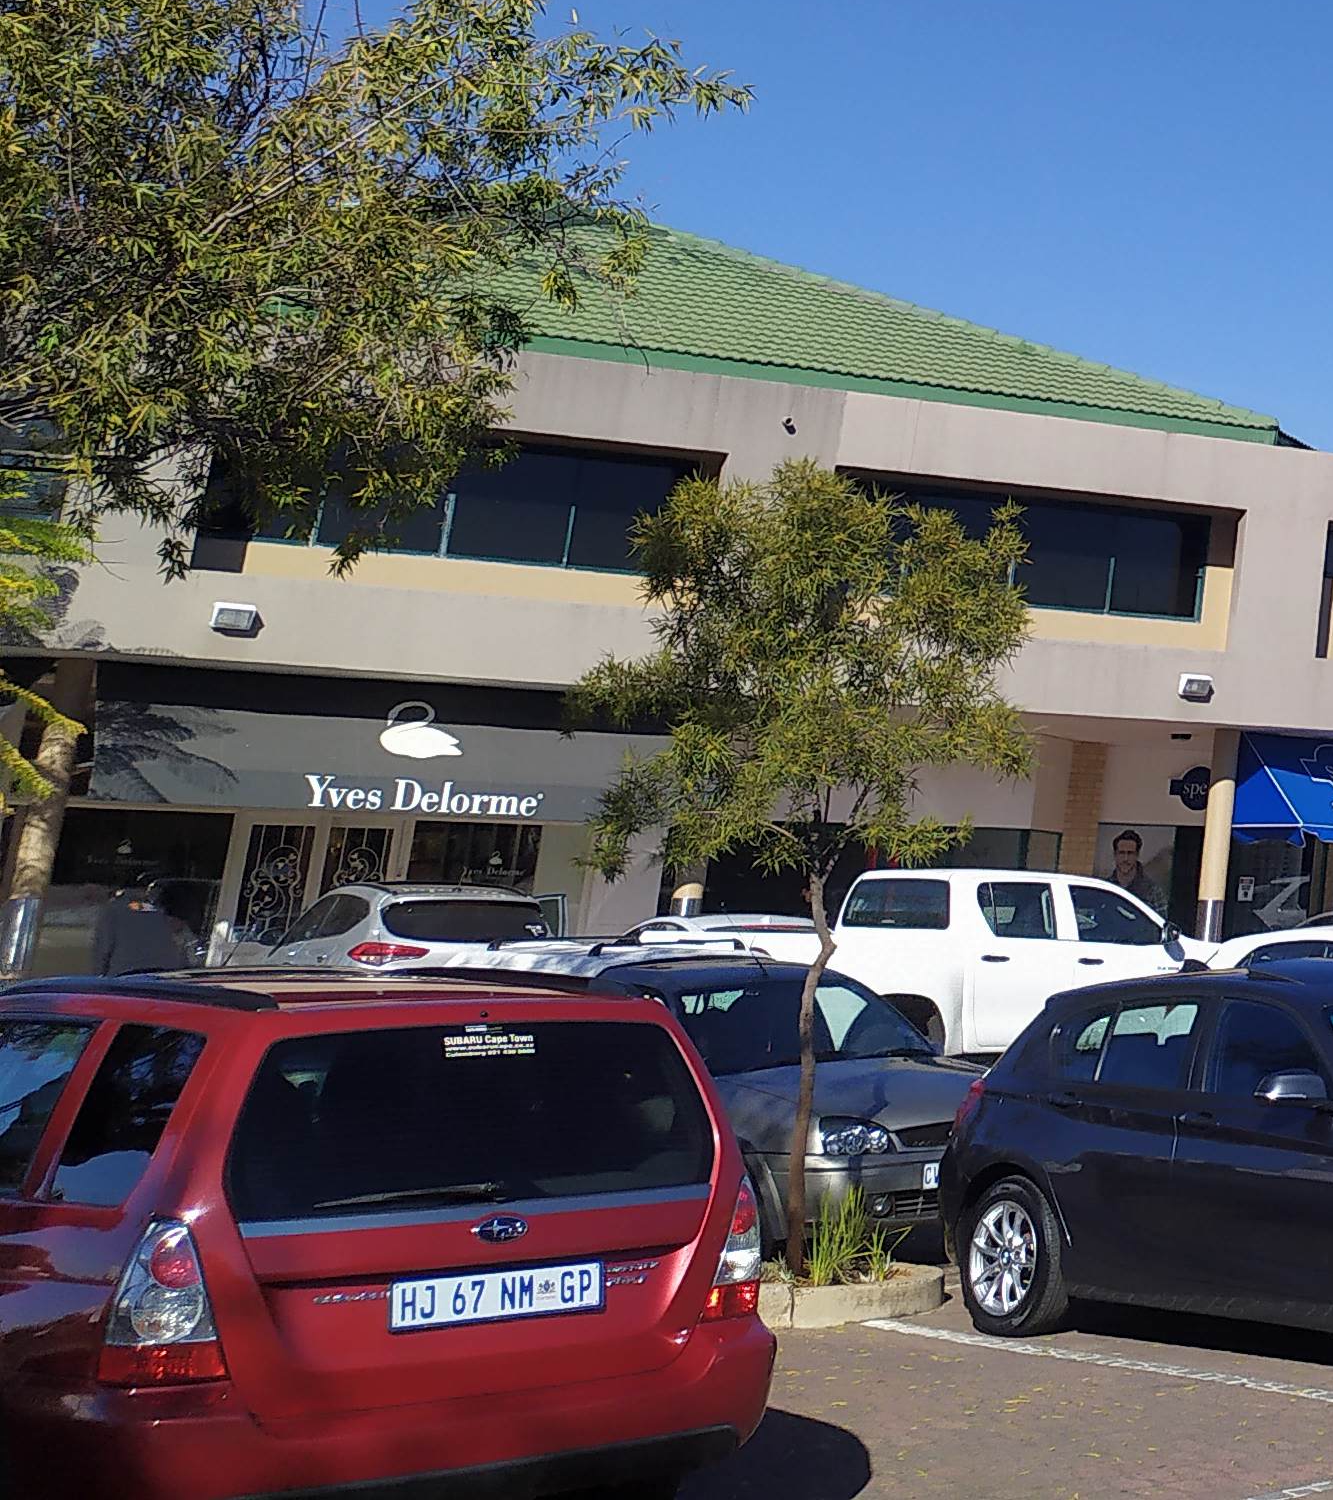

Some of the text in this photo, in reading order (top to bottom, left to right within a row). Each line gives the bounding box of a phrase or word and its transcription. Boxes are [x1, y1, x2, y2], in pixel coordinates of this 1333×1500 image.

[304, 774, 541, 817] Yves Delorme
[443, 1033, 534, 1046] SUBARU Cape Town
[400, 1288, 436, 1322] HJ
[452, 1279, 486, 1316] 67
[500, 1276, 535, 1311] NM
[560, 1269, 592, 1304] GP
